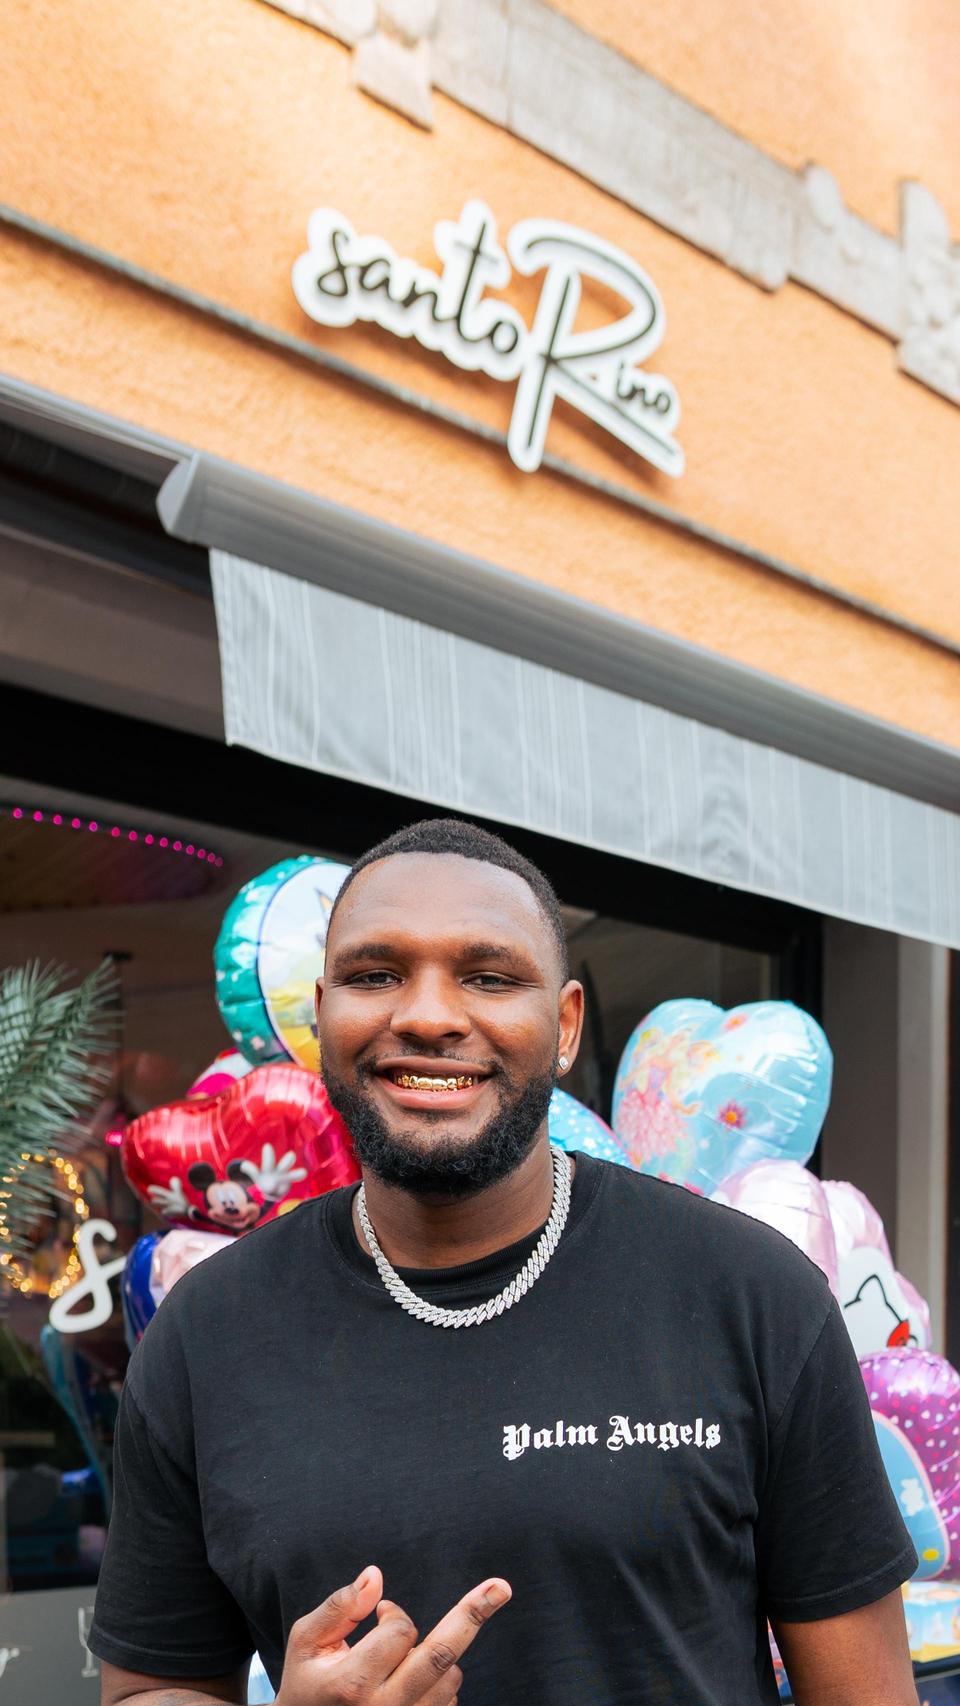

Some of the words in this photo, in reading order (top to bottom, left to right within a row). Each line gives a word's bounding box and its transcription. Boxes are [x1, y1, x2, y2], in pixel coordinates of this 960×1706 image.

[312, 217, 521, 358] santo
[502, 1419, 599, 1461] Palm
[606, 1415, 721, 1451] Angels
